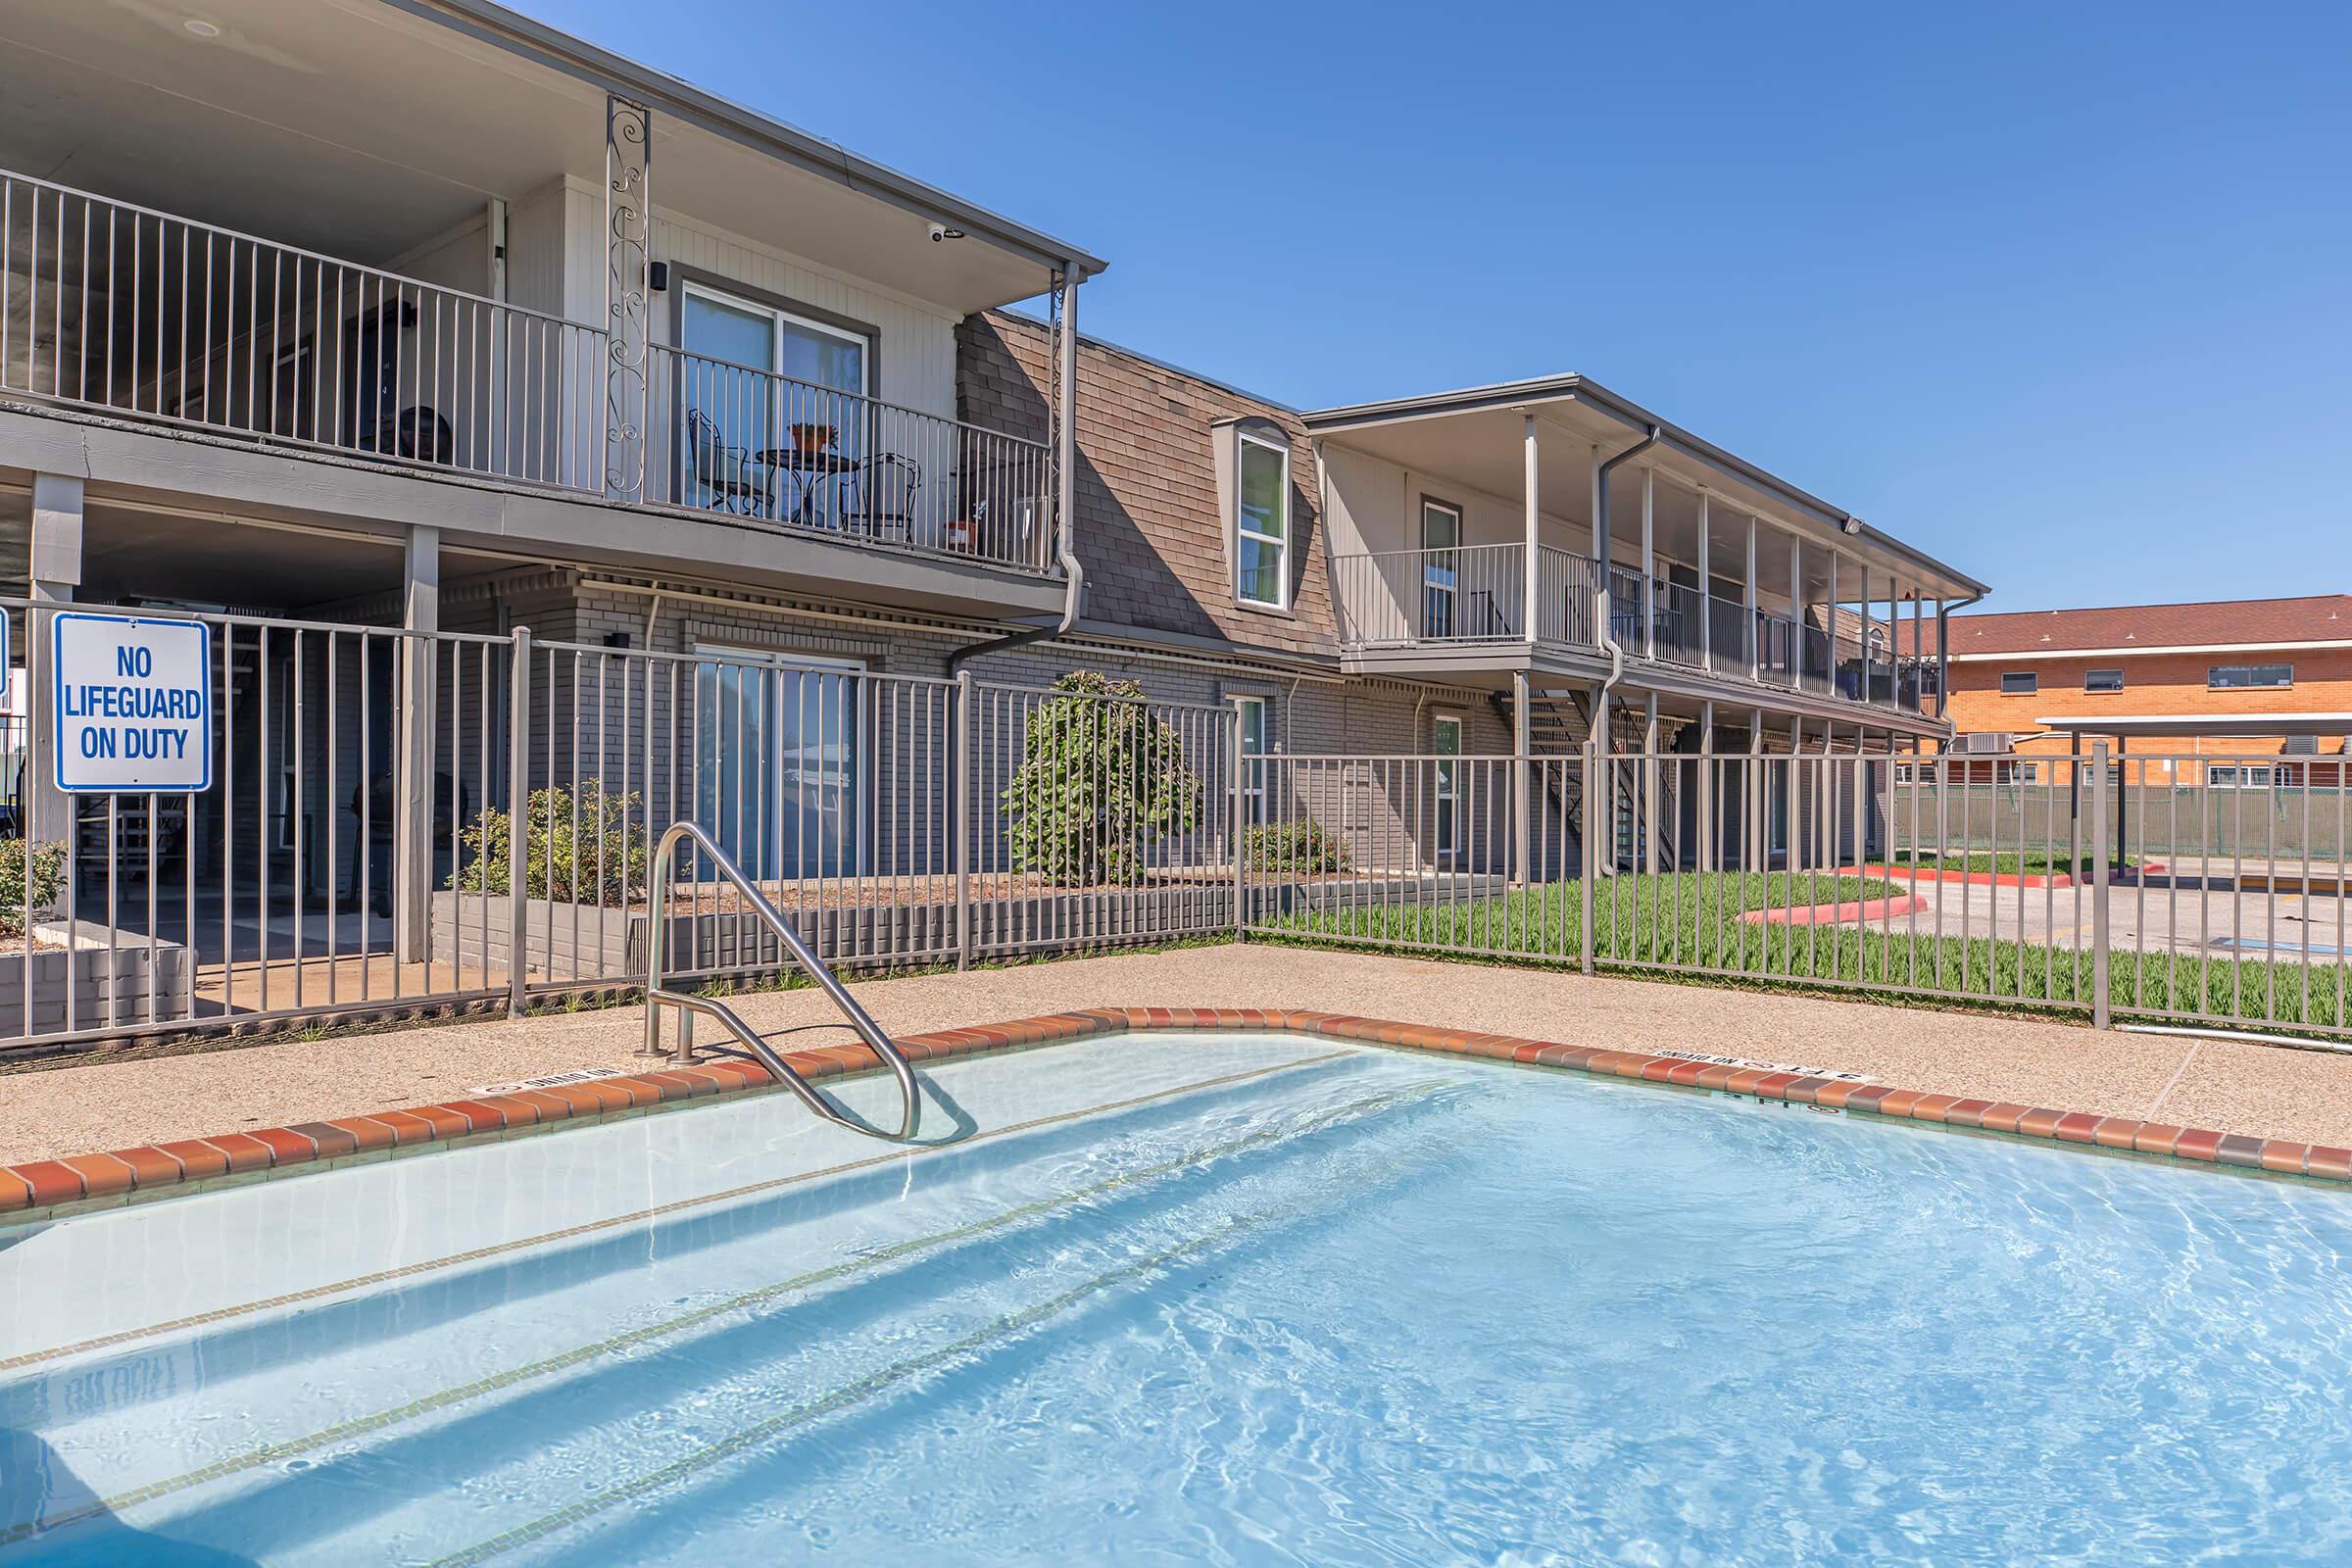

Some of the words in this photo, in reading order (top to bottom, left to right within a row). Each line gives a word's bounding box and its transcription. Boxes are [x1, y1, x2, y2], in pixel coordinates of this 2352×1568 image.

[117, 646, 152, 678] NO
[65, 685, 202, 719] LIFEGUARD
[80, 726, 117, 760] ON
[124, 728, 189, 760] DUTY
[1656, 1050, 1711, 1061] DIVING
[586, 1068, 620, 1077] NO
[1782, 1066, 1826, 1075] FT
[523, 1072, 592, 1087] DIVING
